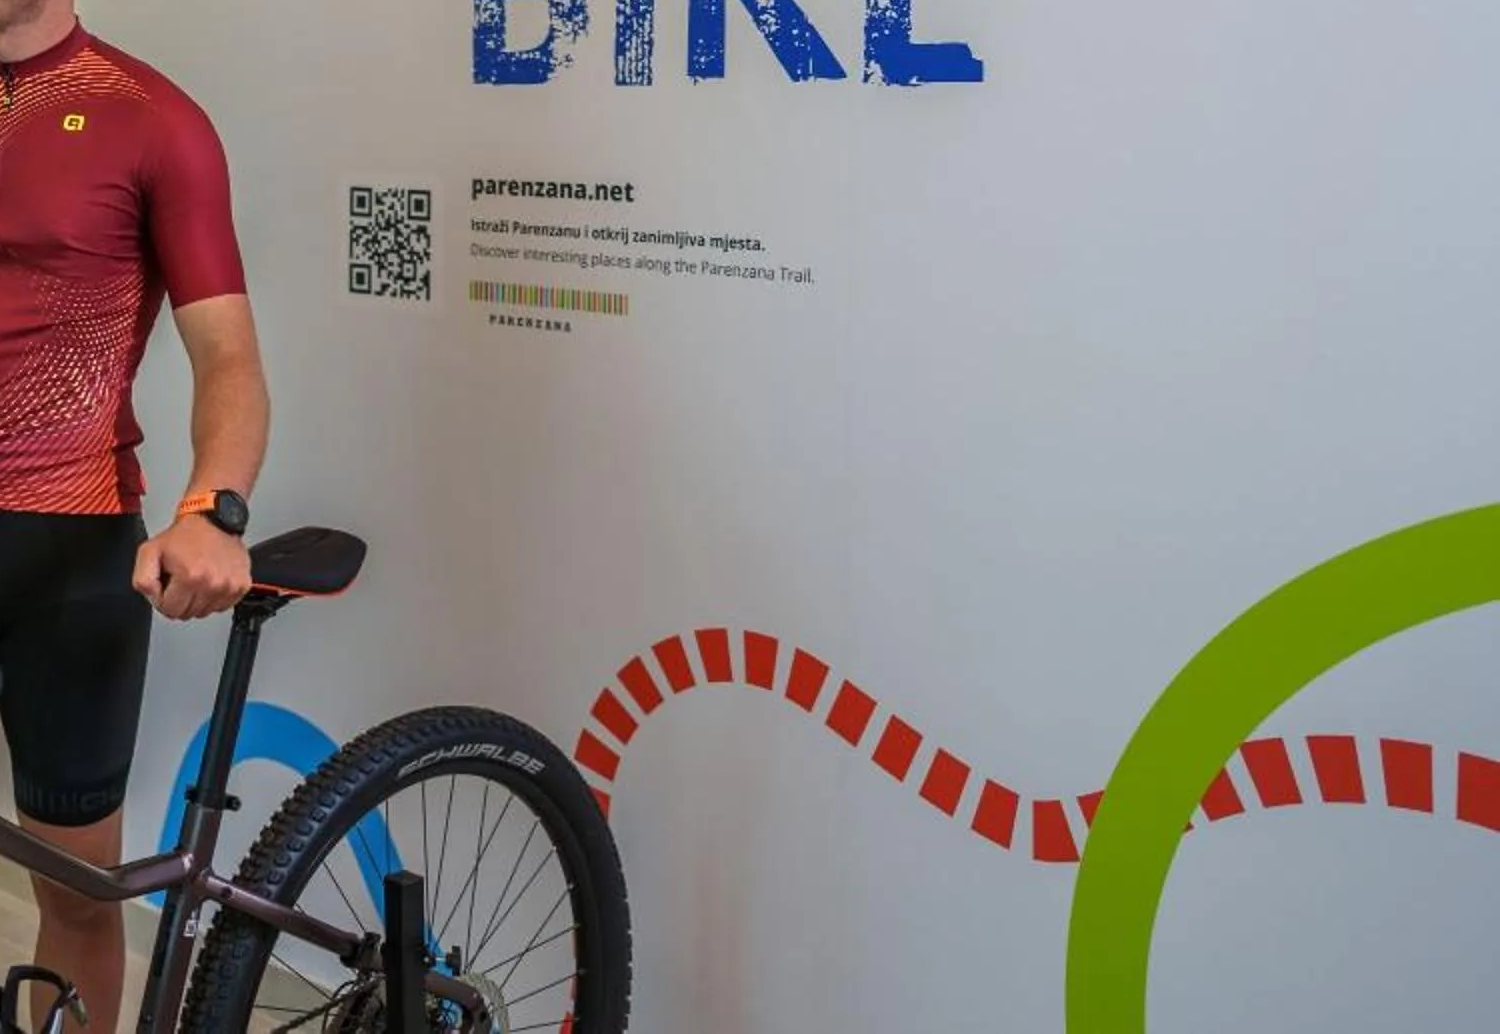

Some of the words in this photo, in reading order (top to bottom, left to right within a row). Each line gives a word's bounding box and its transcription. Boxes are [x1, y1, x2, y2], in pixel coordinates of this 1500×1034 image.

[471, 178, 634, 202] parenzana.net
[471, 219, 509, 233] Istraži
[512, 221, 581, 239] Parenzanu
[591, 226, 629, 245] otkrij
[632, 230, 705, 249] zanimljiva
[709, 234, 766, 252] mjesta.
[470, 243, 519, 259] Discover
[523, 245, 589, 268] interesting
[591, 253, 631, 270] places
[634, 257, 671, 275] along
[675, 259, 697, 274] the
[701, 261, 775, 281] Parenzana
[779, 267, 815, 284] Trail.
[398, 743, 546, 779] SCHWALBE
